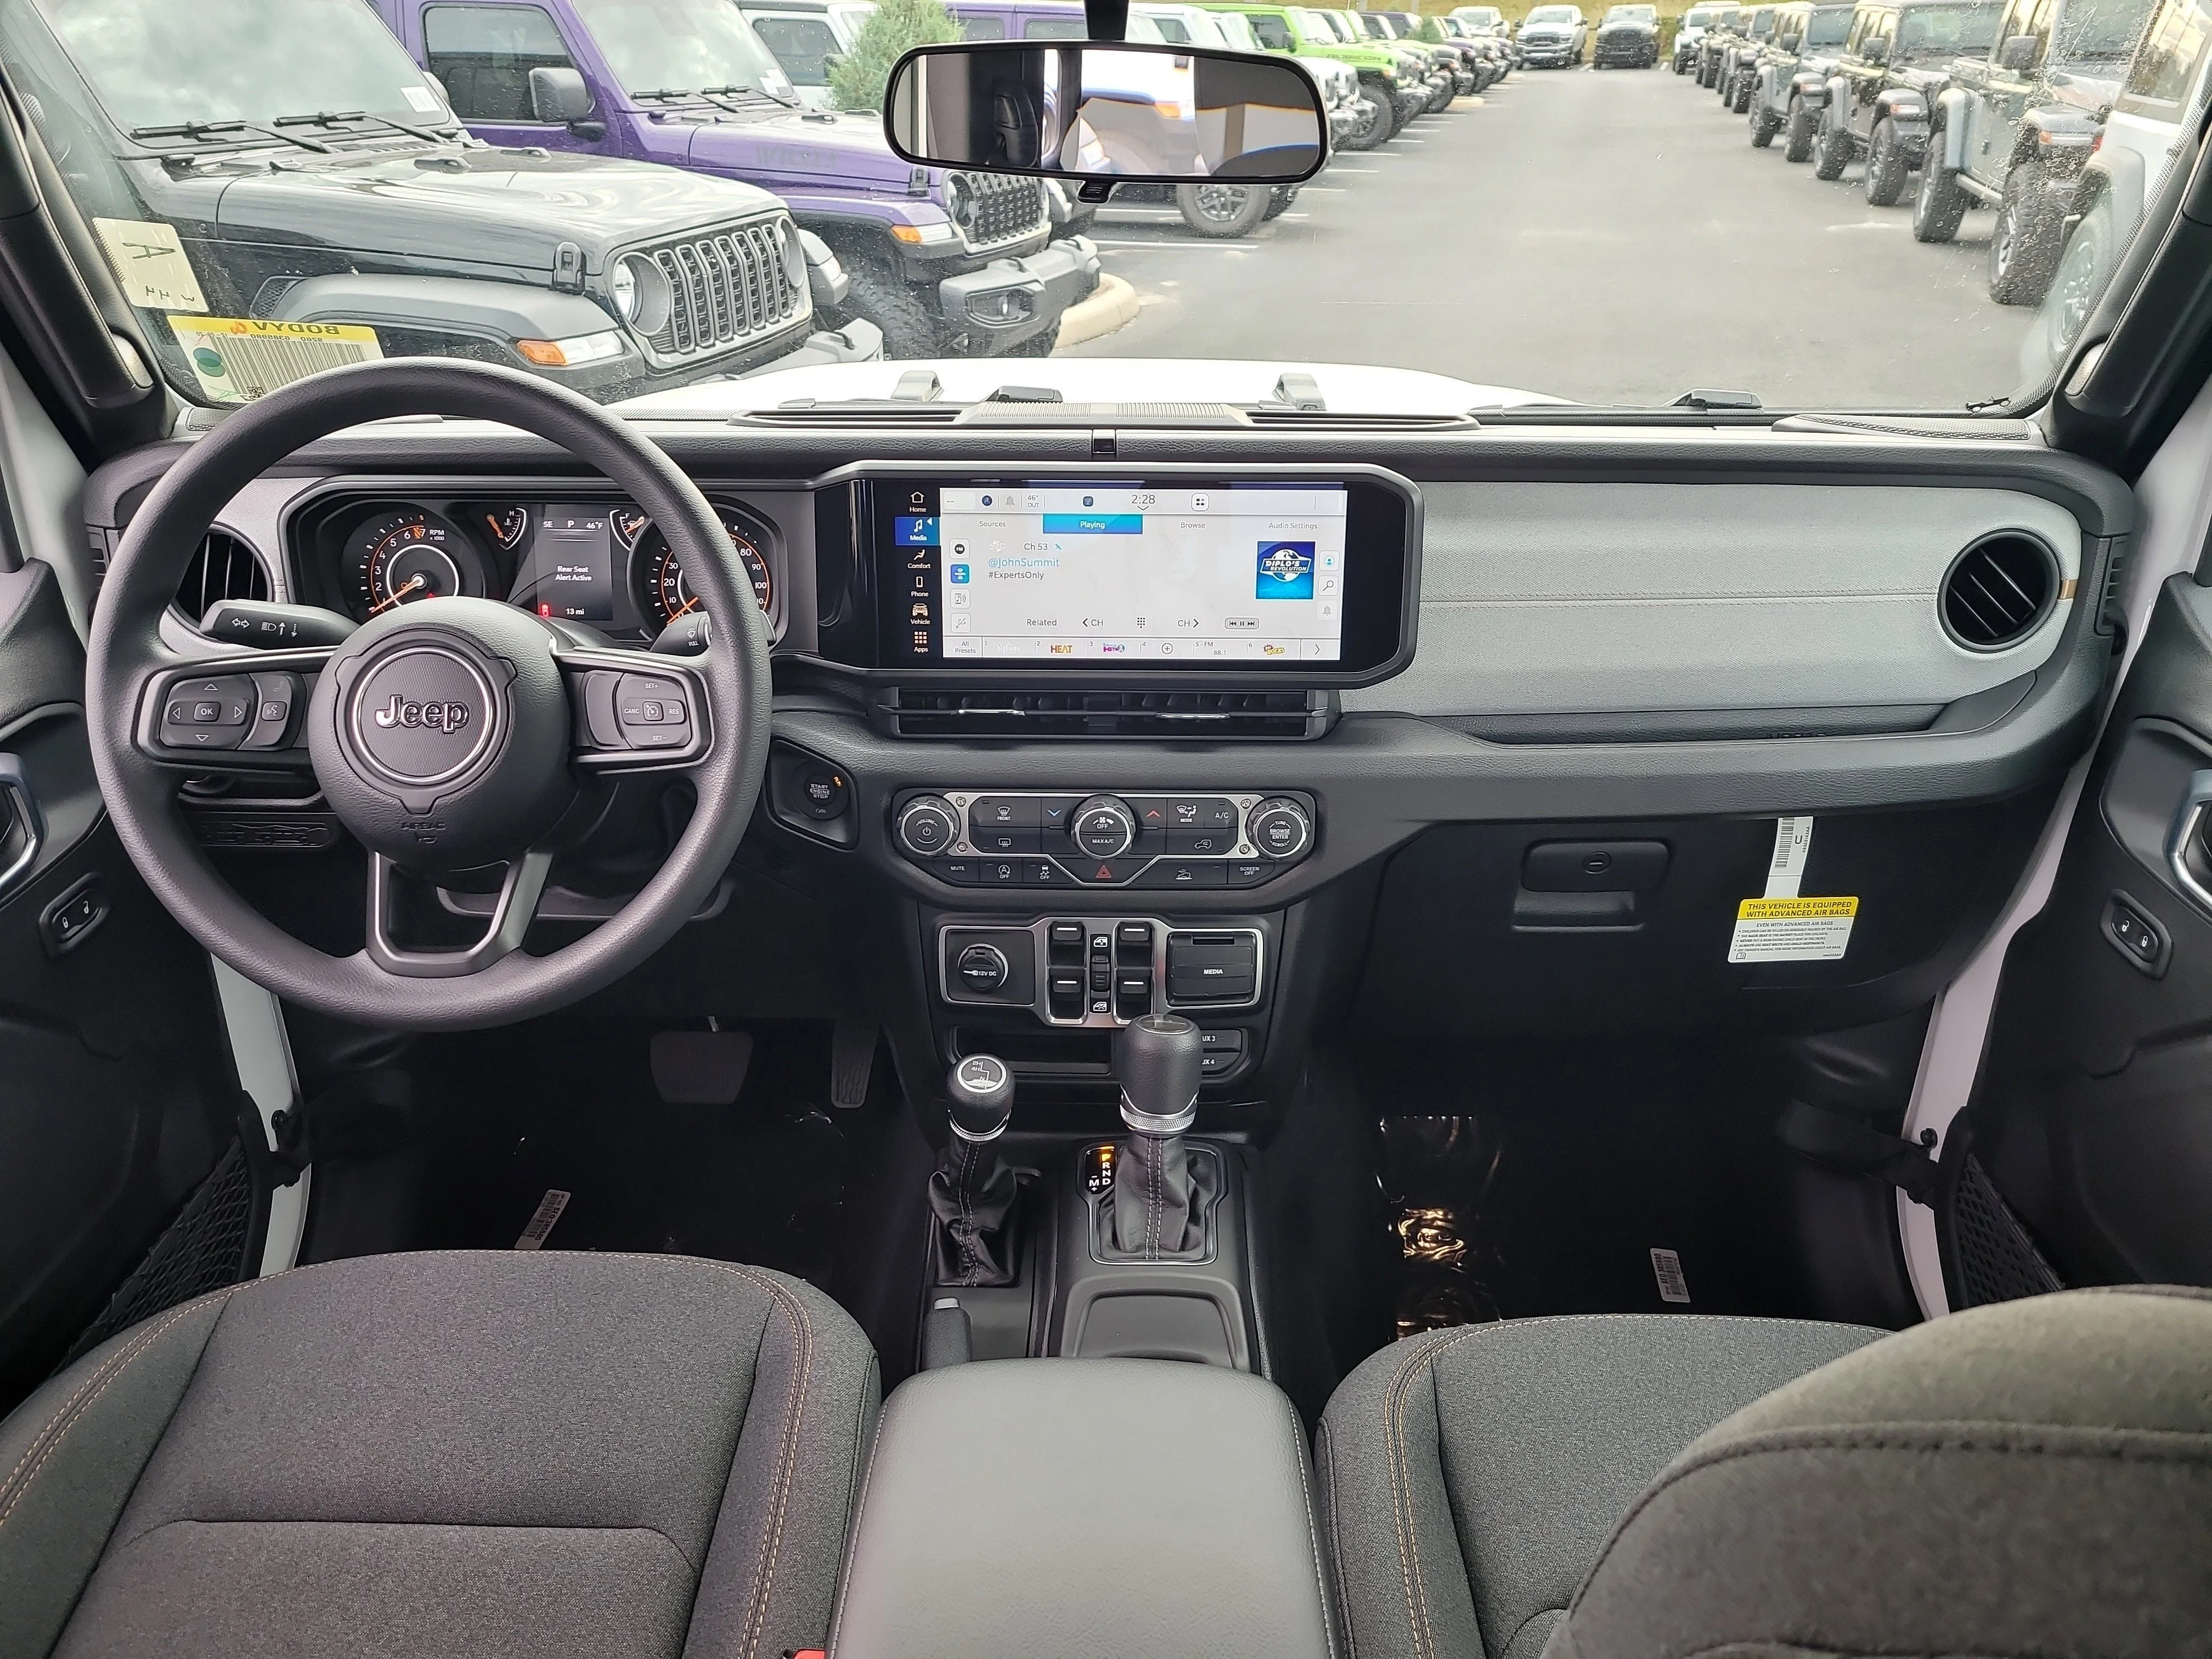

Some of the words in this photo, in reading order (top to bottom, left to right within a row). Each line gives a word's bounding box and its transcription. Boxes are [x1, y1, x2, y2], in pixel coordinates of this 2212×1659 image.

[1131, 495, 1155, 504] 2:28
[404, 531, 411, 539] 6
[390, 538, 397, 546] 5
[379, 550, 386, 560] 4
[989, 558, 1060, 568] @JohnSummit
[375, 566, 381, 574] 3
[989, 571, 1045, 580] #ExpertsOnly
[375, 582, 382, 591] 2
[664, 578, 675, 586] 20
[1051, 645, 1073, 653] HEAT
[375, 695, 470, 733] Jeep
[1795, 835, 1803, 844] U
